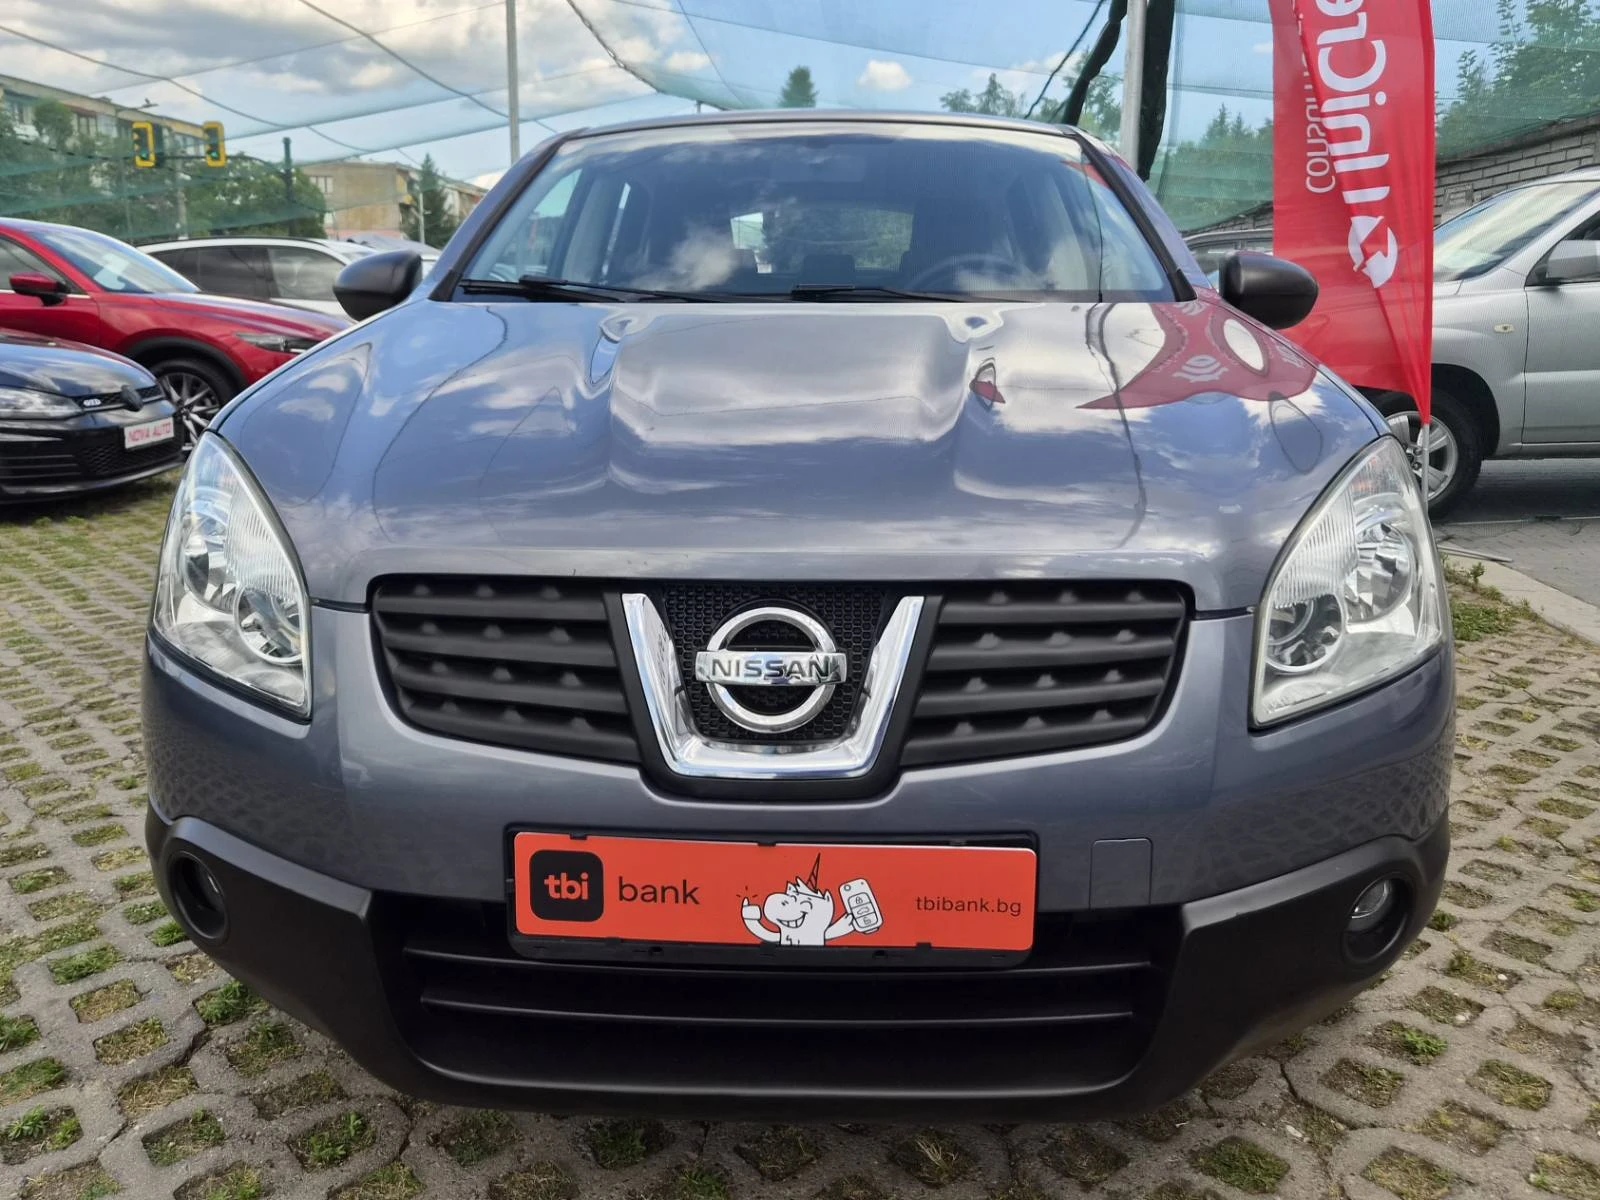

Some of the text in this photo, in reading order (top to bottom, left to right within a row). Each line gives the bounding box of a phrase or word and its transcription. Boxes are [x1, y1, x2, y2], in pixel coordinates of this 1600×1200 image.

[127, 421, 172, 443] NOVA AUTO
[711, 656, 830, 678] NISSAN
[544, 872, 701, 905] tbi bank
[916, 896, 1022, 917] tbibank.bg
